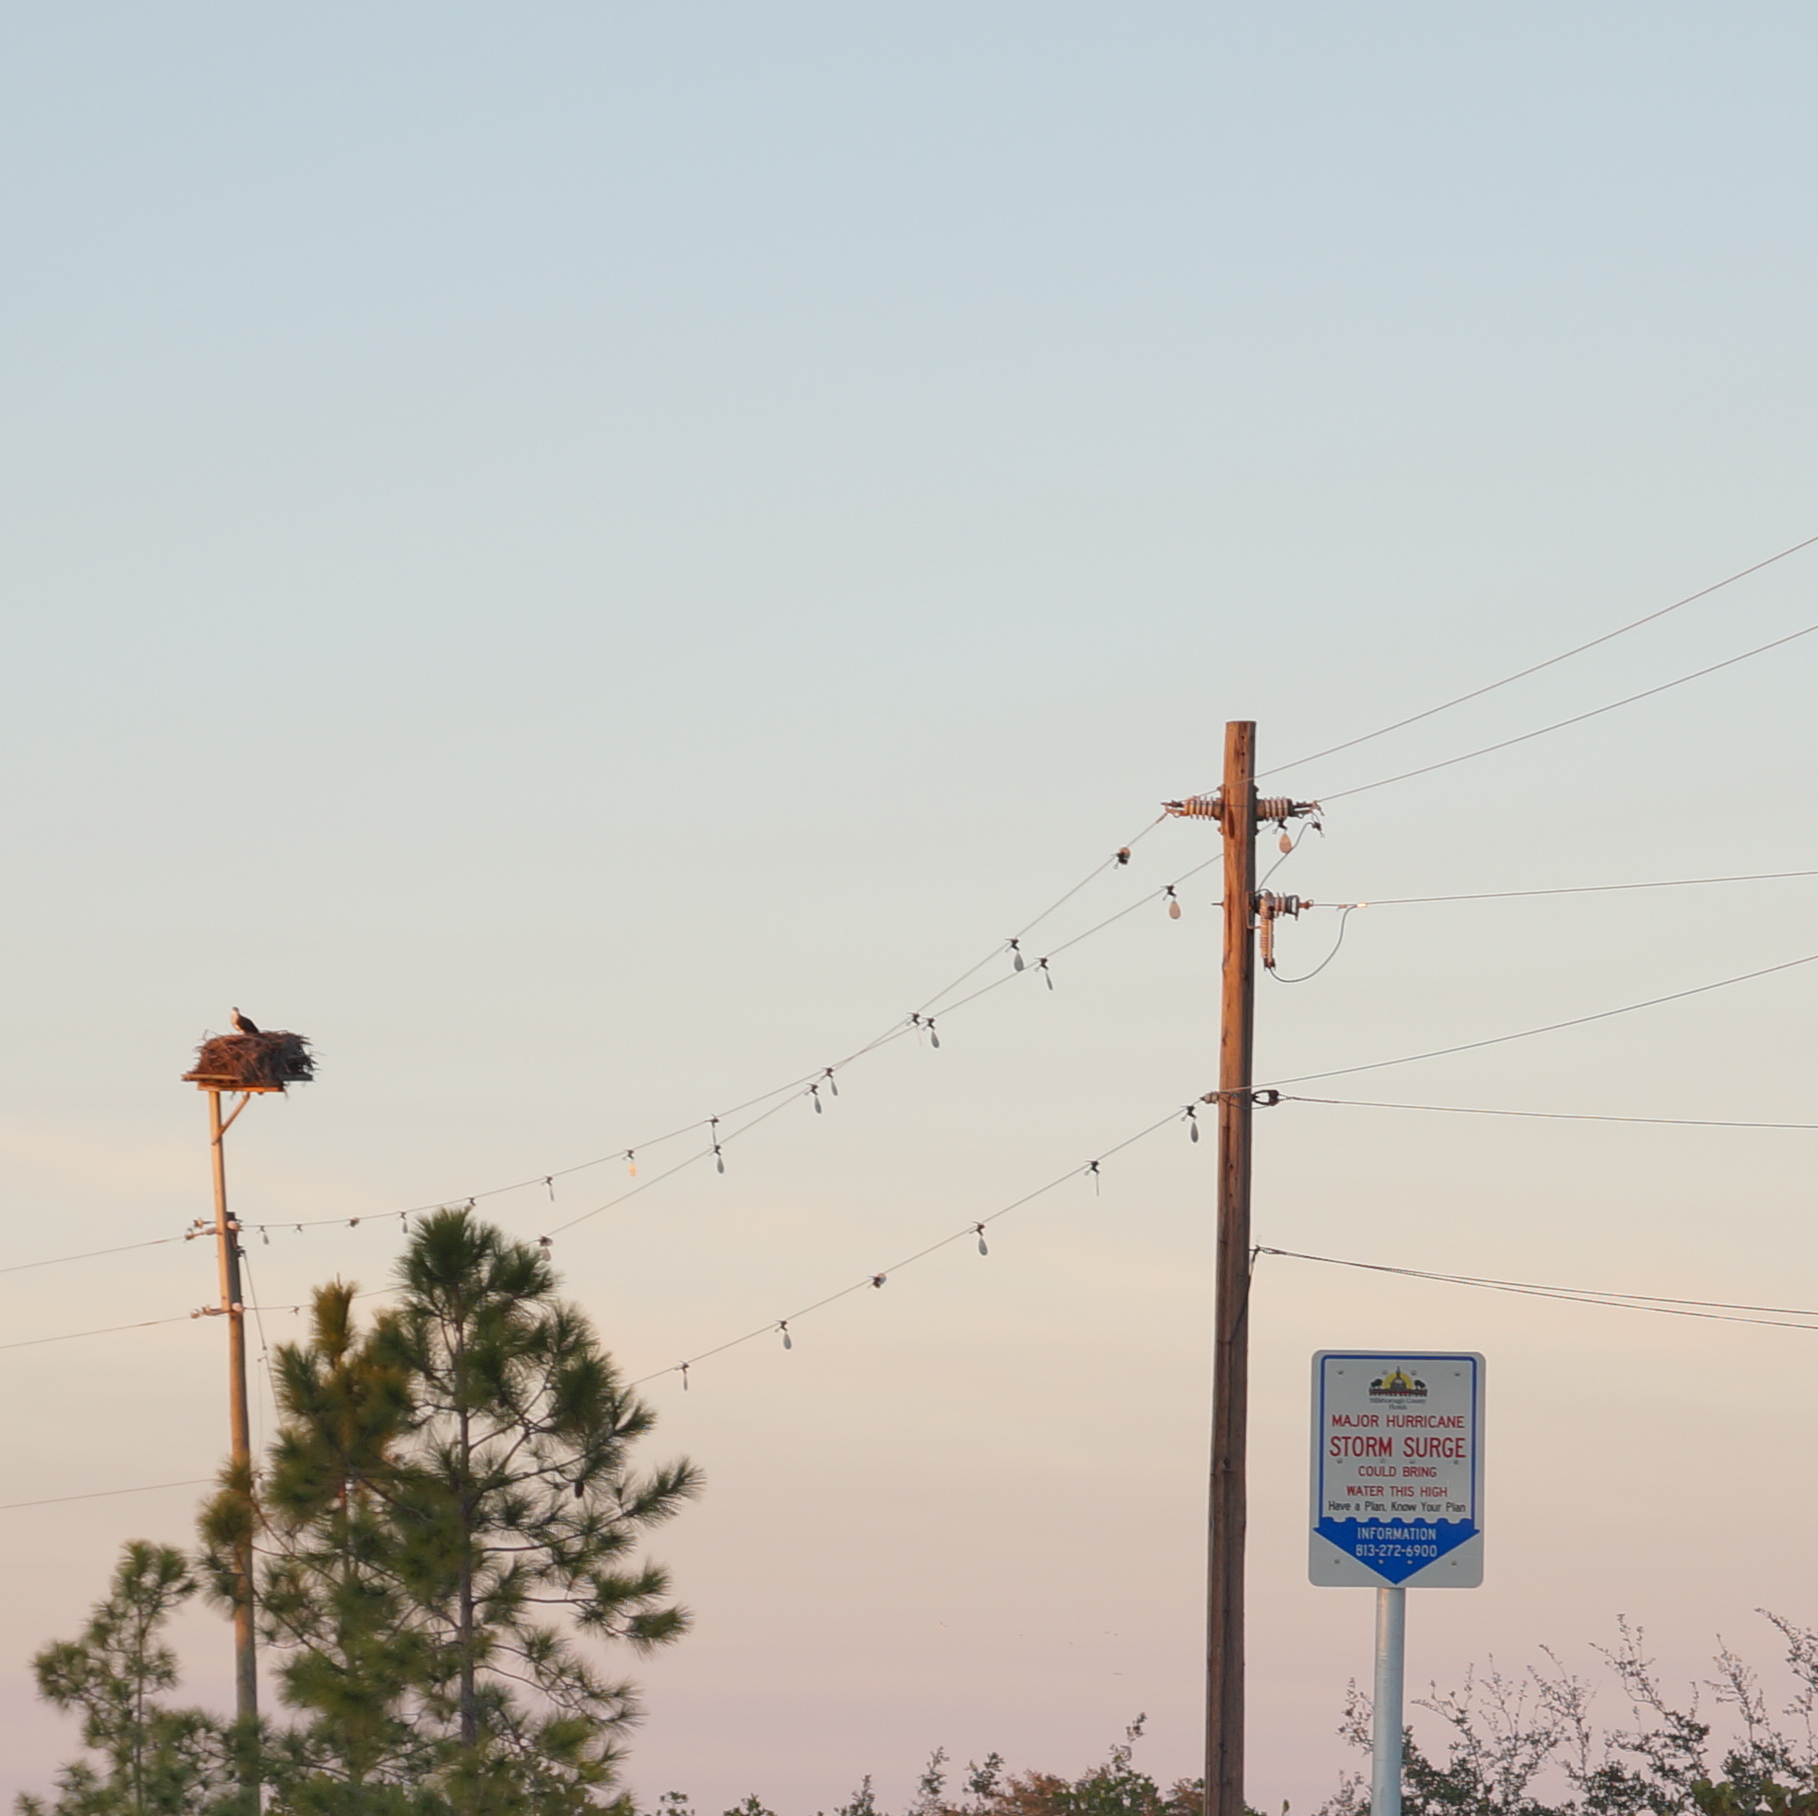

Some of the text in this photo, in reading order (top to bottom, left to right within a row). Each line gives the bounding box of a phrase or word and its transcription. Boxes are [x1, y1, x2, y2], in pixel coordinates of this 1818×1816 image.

[1332, 1414, 1465, 1429] MAJOR HURRICANE
[1329, 1436, 1466, 1458] STORM SURGE
[1358, 1466, 1437, 1477] COULD BRING
[1346, 1486, 1448, 1498] WATER THIS HIGH
[1328, 1501, 1351, 1511] Have
[1354, 1503, 1361, 1511] a
[1391, 1501, 1417, 1512] Know
[1420, 1502, 1443, 1512] Your
[1446, 1502, 1466, 1512] Plan
[1357, 1527, 1436, 1540] INFORMATION
[1355, 1544, 1437, 1558] 813-272-6900
